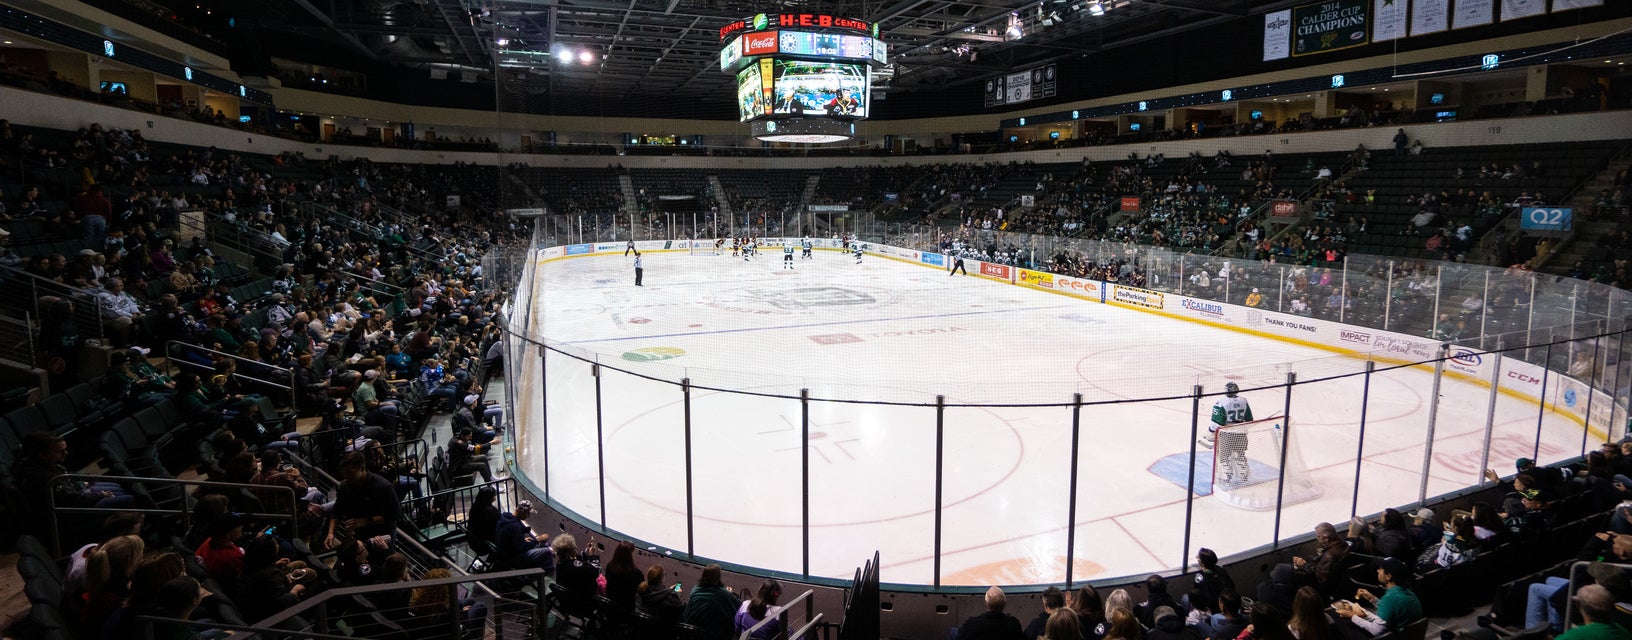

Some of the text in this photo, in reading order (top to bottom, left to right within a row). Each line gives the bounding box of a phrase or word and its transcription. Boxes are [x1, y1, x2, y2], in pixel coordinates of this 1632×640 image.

[1321, 1, 1341, 13] 2014
[780, 14, 867, 30] H-E-B CENTER
[1301, 9, 1339, 26] CALDER
[1340, 5, 1361, 18] CUP
[1297, 13, 1365, 36] CHAMPIONS
[1530, 209, 1563, 225] Q2
[1181, 299, 1223, 314] EXCALIBUR
[1265, 317, 1317, 333] THANK YOU FANS!
[1340, 331, 1371, 343] IMPACT
[1507, 370, 1541, 385] CCM
